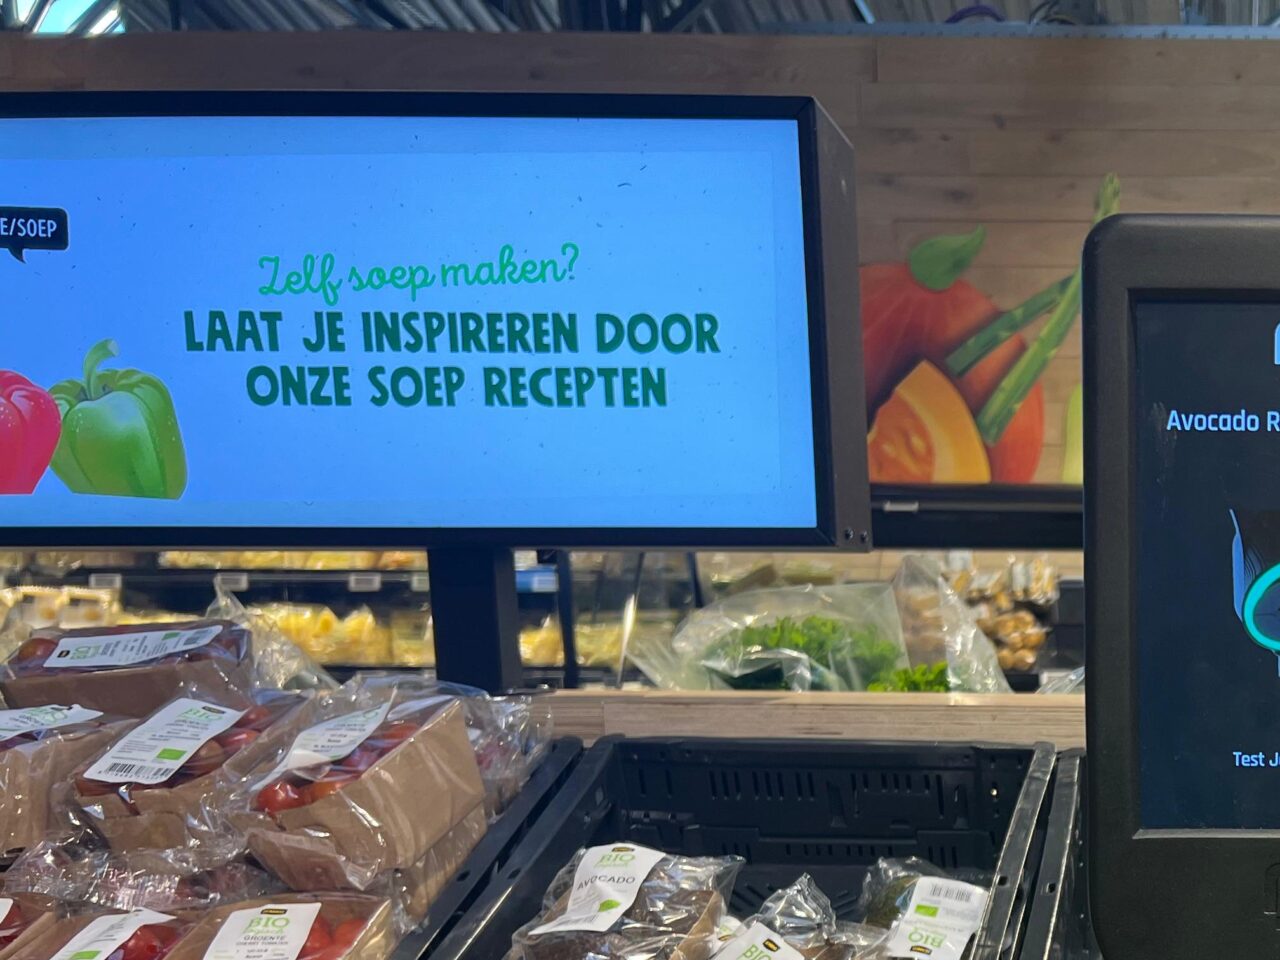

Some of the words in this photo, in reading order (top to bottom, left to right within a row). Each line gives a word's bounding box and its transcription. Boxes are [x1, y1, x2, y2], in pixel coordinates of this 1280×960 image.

[258, 256, 340, 306] Zelf
[346, 256, 436, 302] soep
[440, 242, 580, 289] maken?
[182, 310, 283, 353] LAAT
[302, 310, 347, 353] JE
[362, 311, 578, 354] INSPIREREN
[596, 313, 721, 354] DOOR
[246, 365, 351, 407] ONZE
[369, 366, 464, 408] SOEP
[483, 366, 668, 408] RECEPTEN
[1166, 409, 1259, 433] Avocado
[1233, 751, 1265, 767] Test
[577, 875, 636, 891] AVOCADO
[247, 917, 290, 928] BIO
